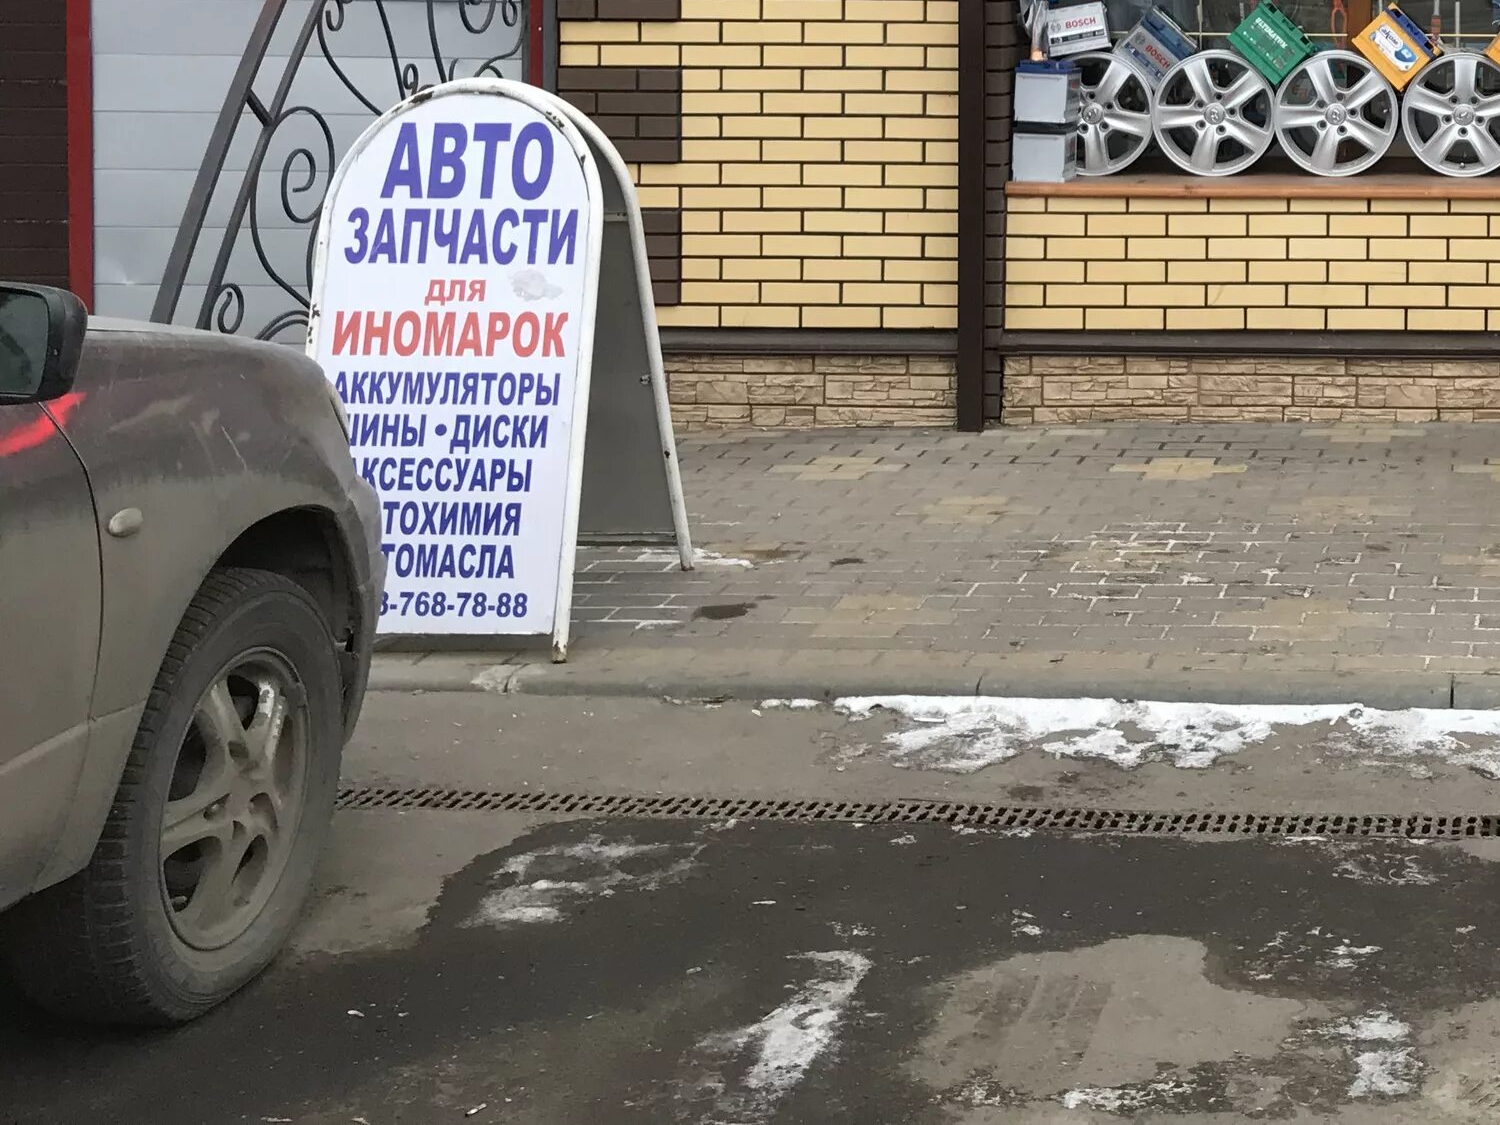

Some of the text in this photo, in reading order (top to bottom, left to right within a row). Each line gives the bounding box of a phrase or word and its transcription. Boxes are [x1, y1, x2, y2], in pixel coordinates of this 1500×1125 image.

[1065, 17, 1097, 29] BOSCH
[1145, 44, 1171, 69] BOSCH
[380, 122, 555, 201] АВТО
[344, 207, 579, 265] ЗАПЧАСТИ
[331, 311, 569, 357] ИНОМАРОК
[334, 370, 561, 406] АККУМУЛЯТОРЫ
[449, 414, 549, 454] ДИСКИ
[353, 457, 533, 492] КСЕССУАРЫ
[382, 500, 522, 536] ТОХИМИЯ
[381, 543, 515, 579] ТОМАСЛА
